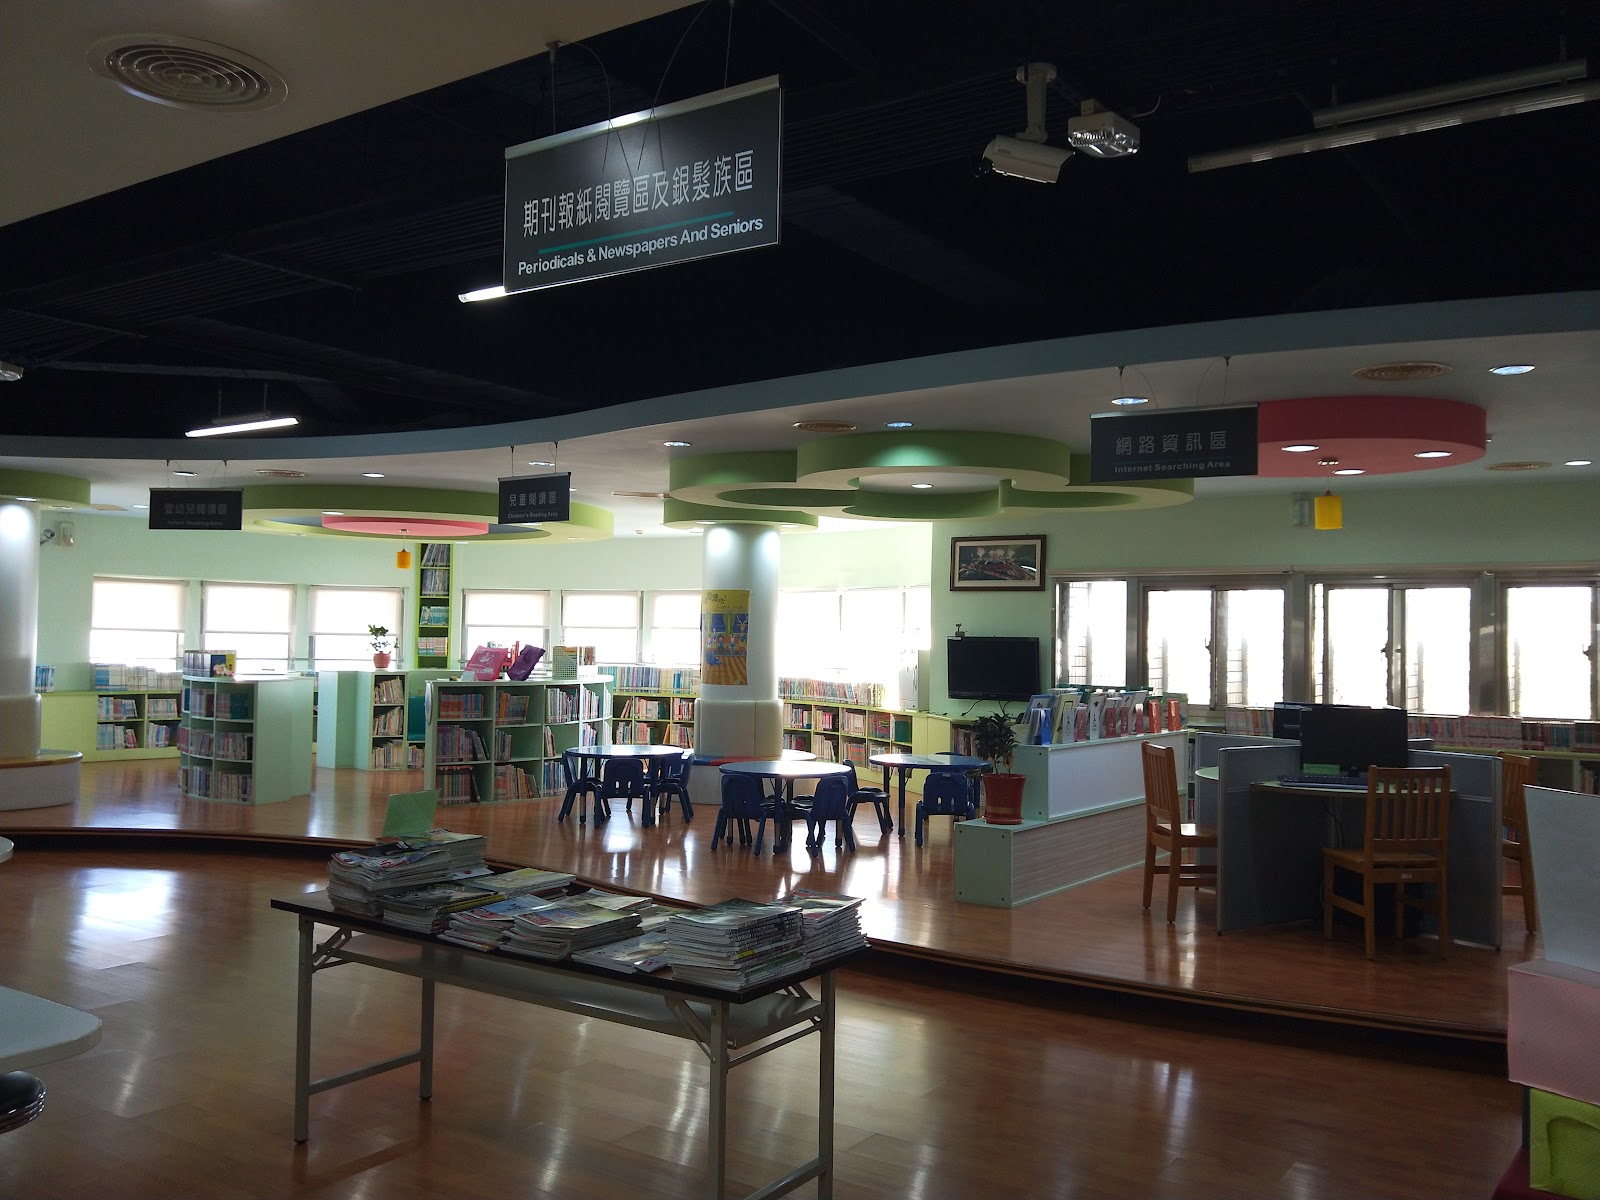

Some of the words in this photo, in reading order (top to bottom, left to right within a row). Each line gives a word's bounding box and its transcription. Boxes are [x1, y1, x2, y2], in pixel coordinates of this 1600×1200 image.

[518, 252, 584, 276] Periodicals
[587, 248, 597, 262] &
[598, 235, 678, 261] Newspapers
[680, 225, 708, 245] And
[711, 217, 764, 239] Seniors
[1115, 431, 1226, 455] 網路資訊區
[1114, 465, 1152, 473] Internet
[1155, 461, 1205, 471] Searching
[1208, 460, 1231, 468] Area
